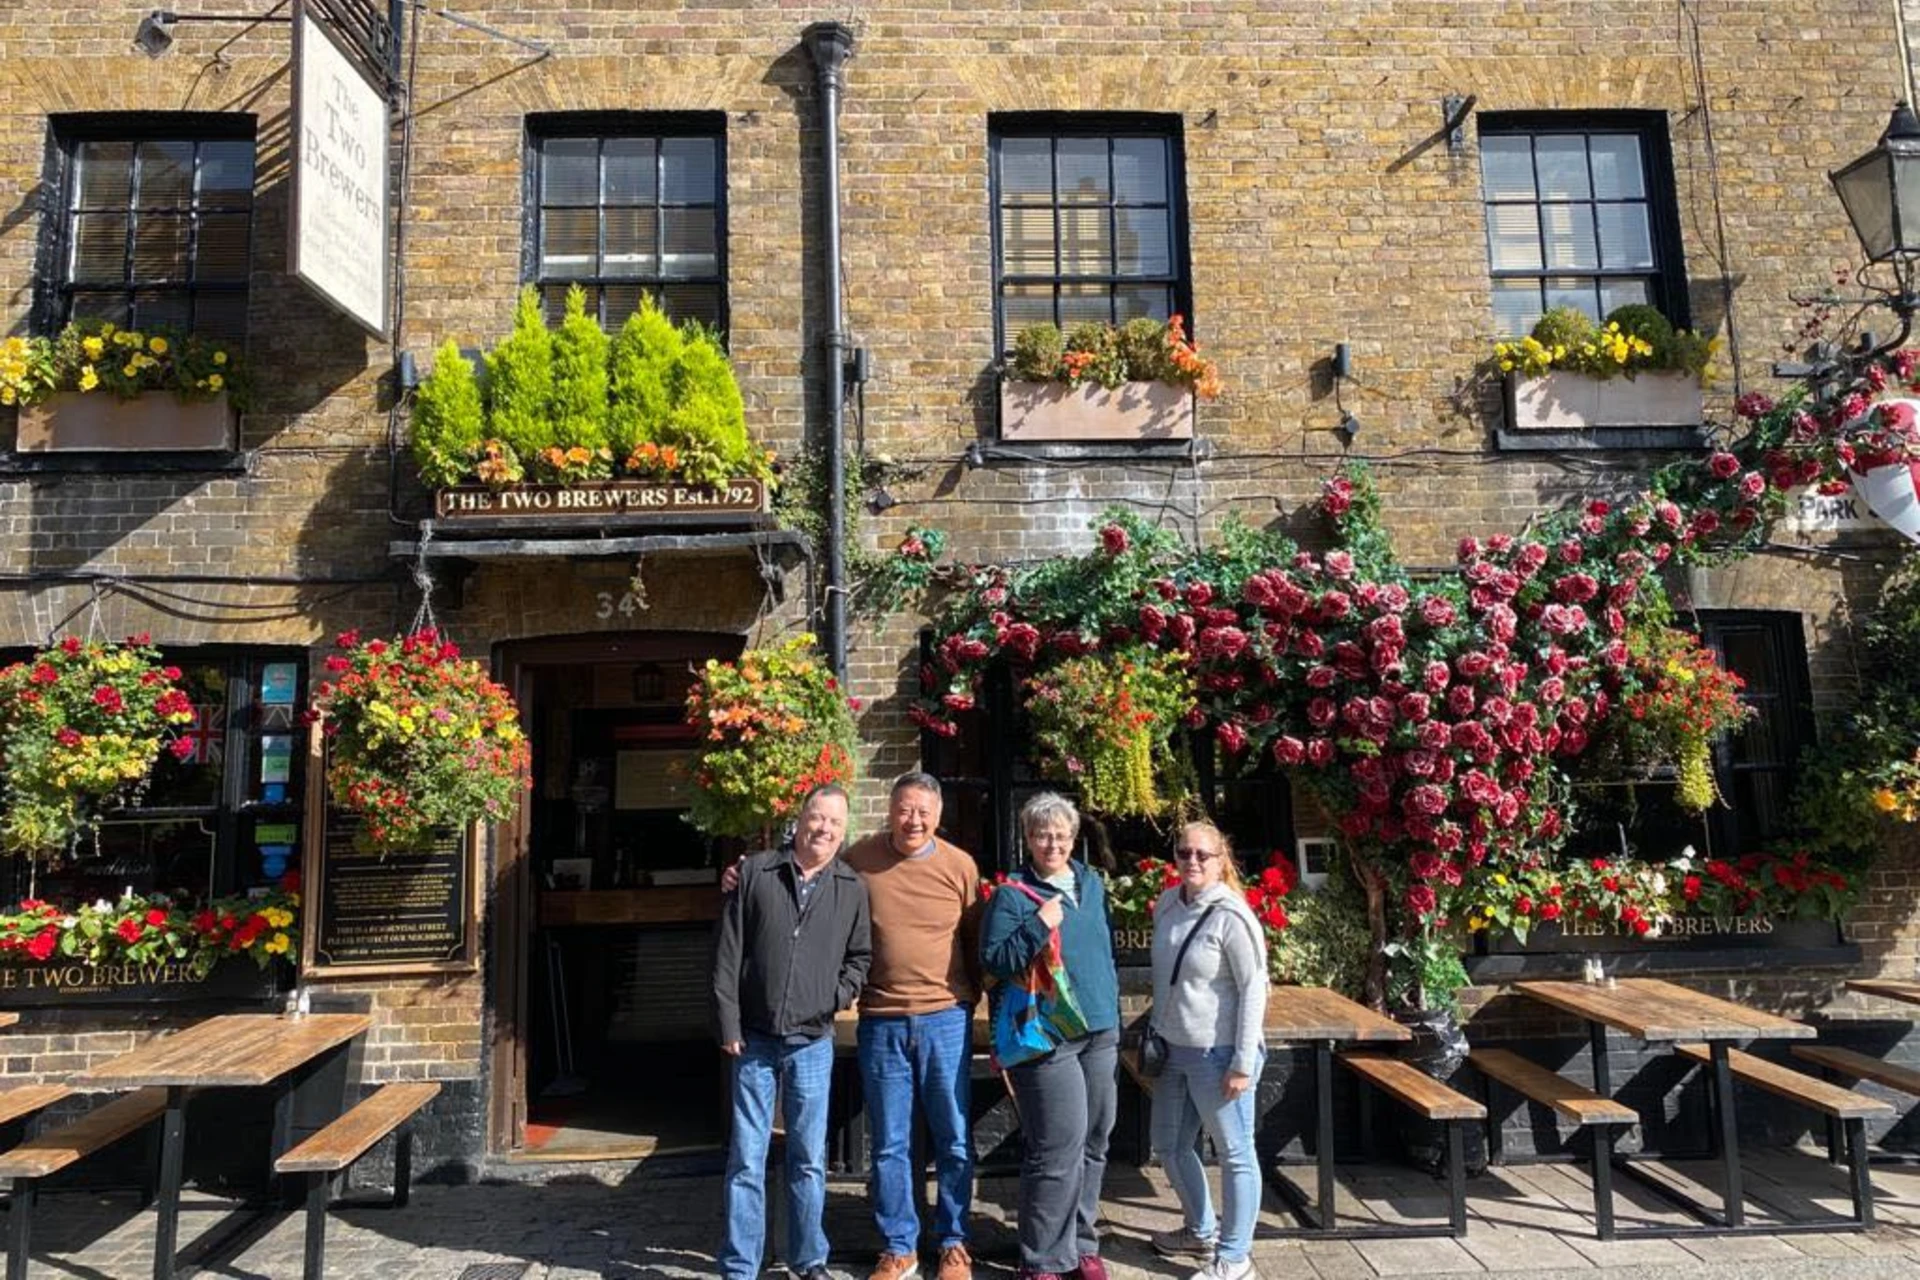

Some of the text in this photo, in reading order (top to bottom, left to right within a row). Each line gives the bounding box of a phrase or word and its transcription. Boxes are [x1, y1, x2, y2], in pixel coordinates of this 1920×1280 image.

[333, 74, 359, 122] The
[325, 101, 366, 170] Two
[305, 126, 380, 230] Brewers
[443, 492, 492, 510] THE
[498, 490, 552, 509] TWO
[557, 487, 668, 508] BREWERS
[1798, 495, 1859, 520] PARK
[1561, 917, 1606, 936] THE
[1670, 914, 1774, 935] BREWERS
[1113, 930, 1153, 948] BRE
[23, 966, 84, 989] TWO
